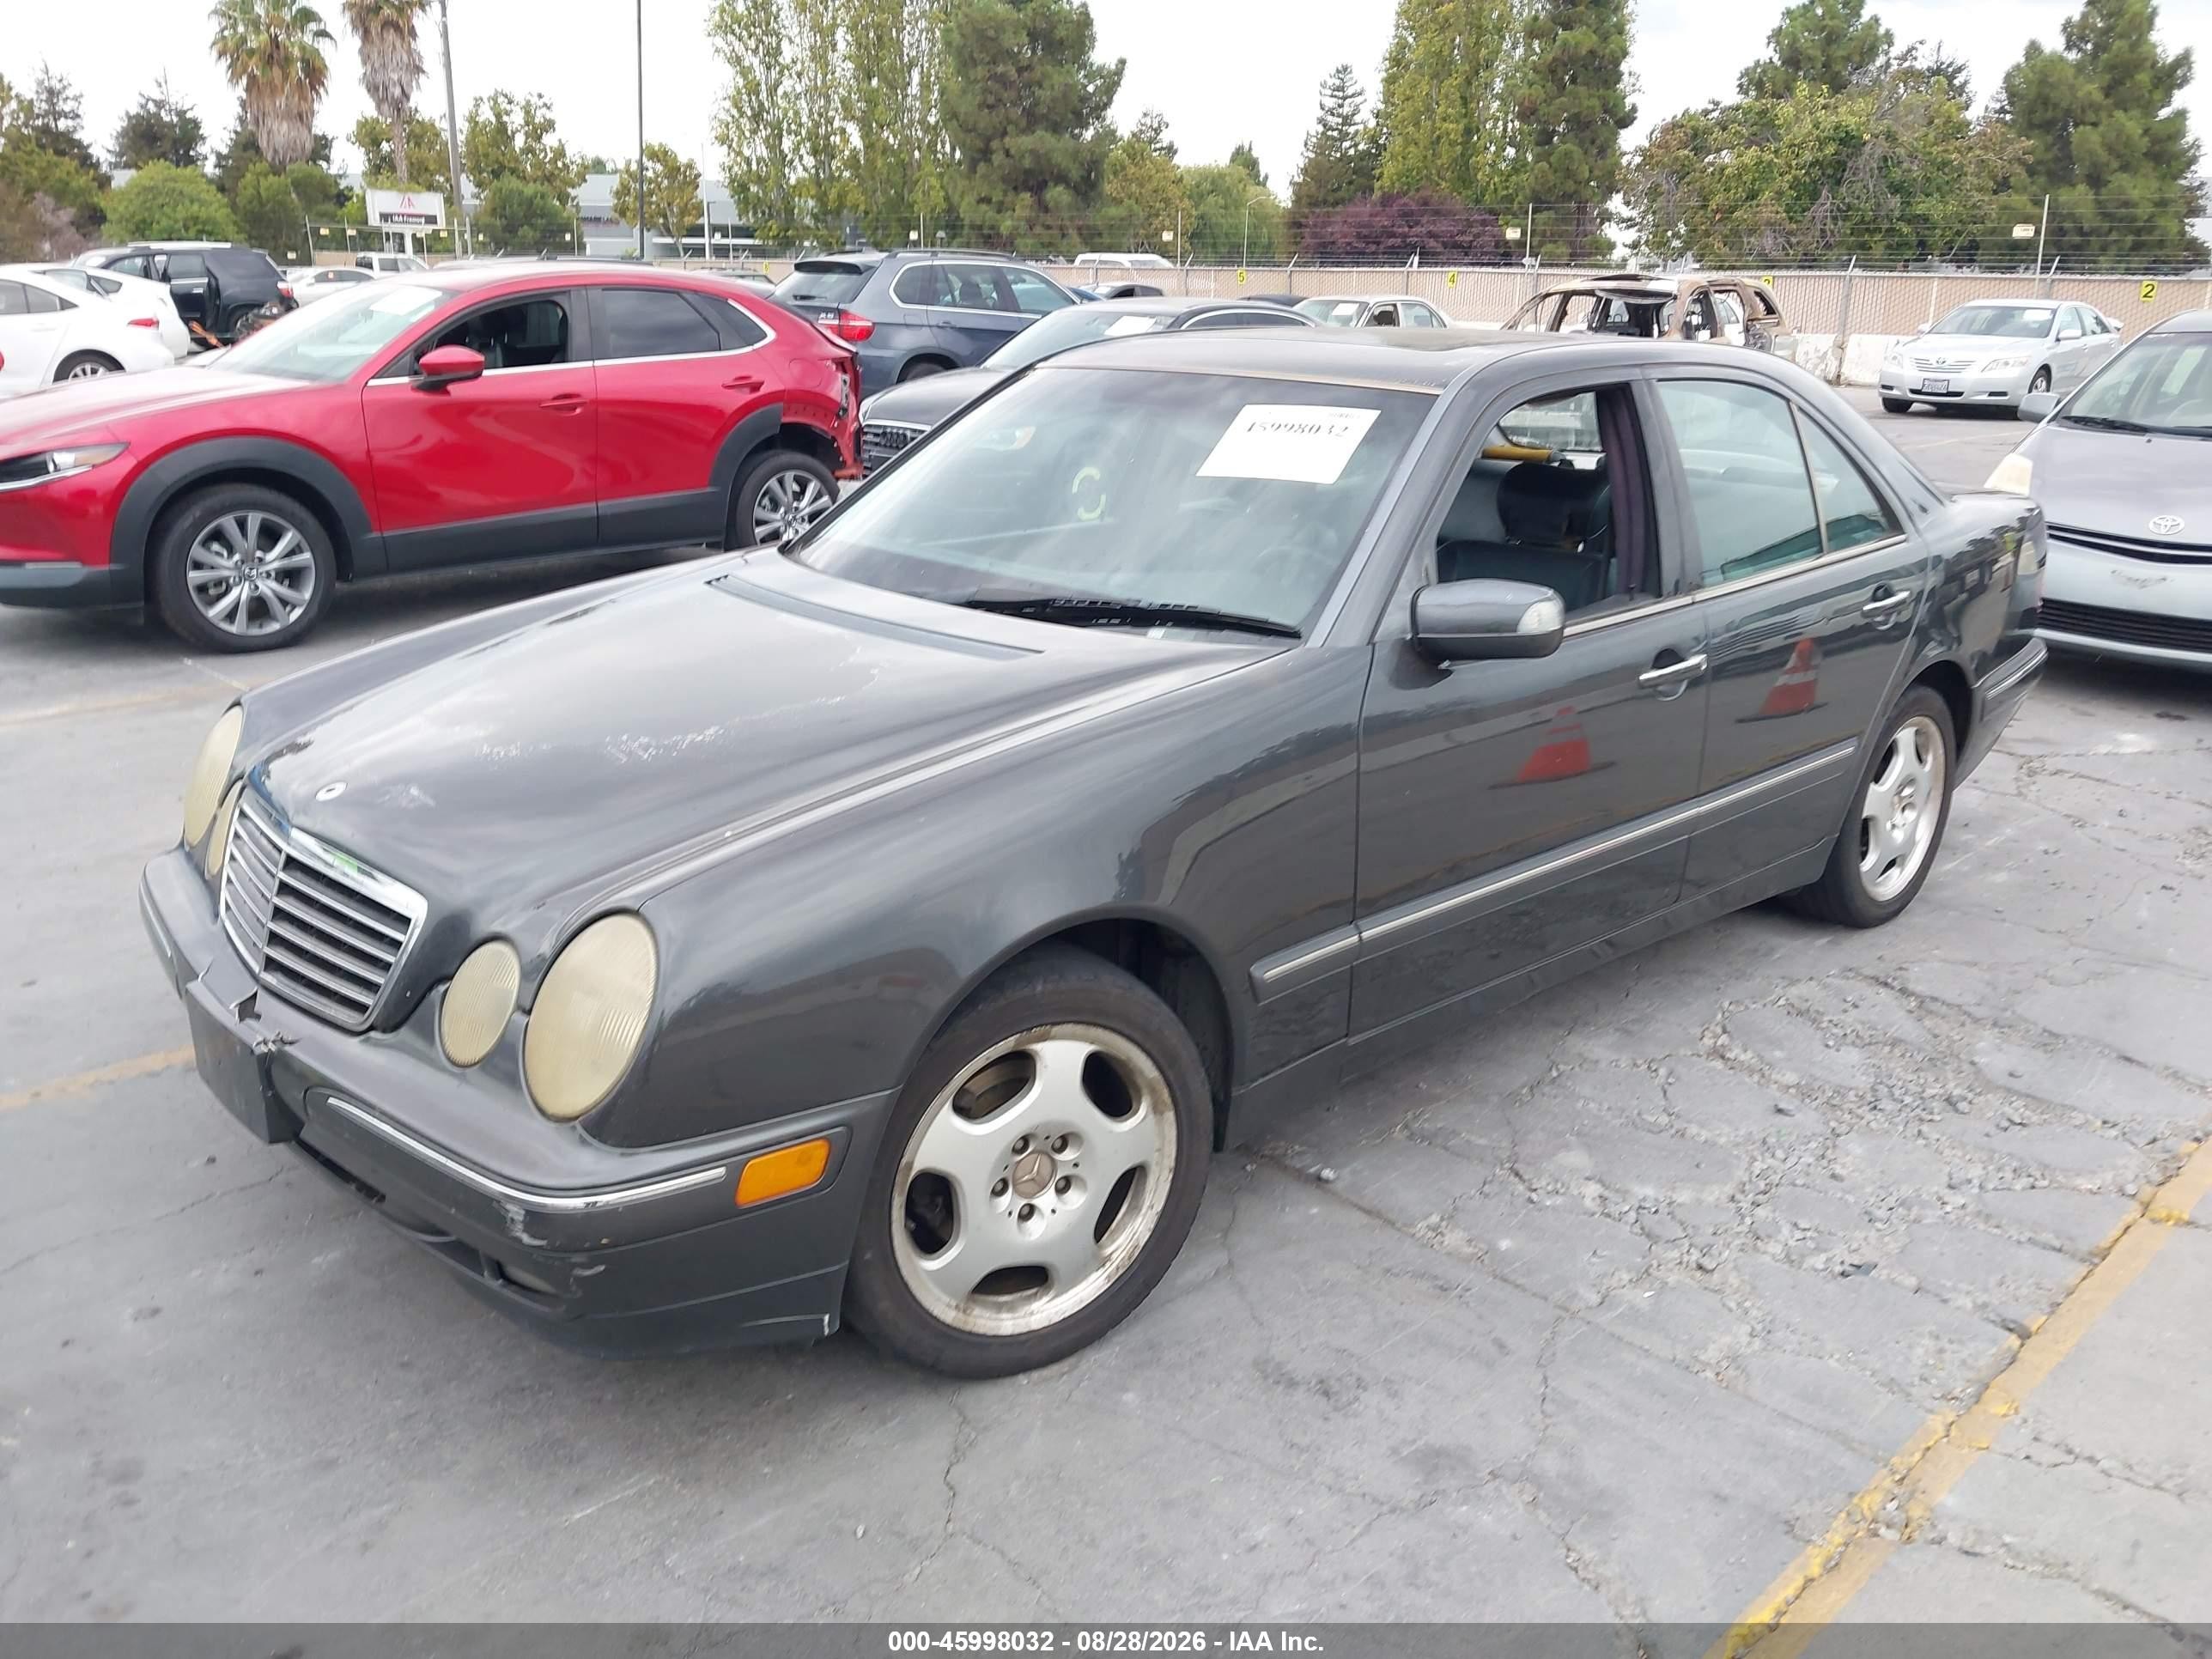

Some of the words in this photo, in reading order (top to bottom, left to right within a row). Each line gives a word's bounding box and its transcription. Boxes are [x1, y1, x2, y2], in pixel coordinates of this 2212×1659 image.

[1239, 271, 1244, 283] 5
[1449, 273, 1455, 284] 4
[2142, 283, 2155, 298] 2
